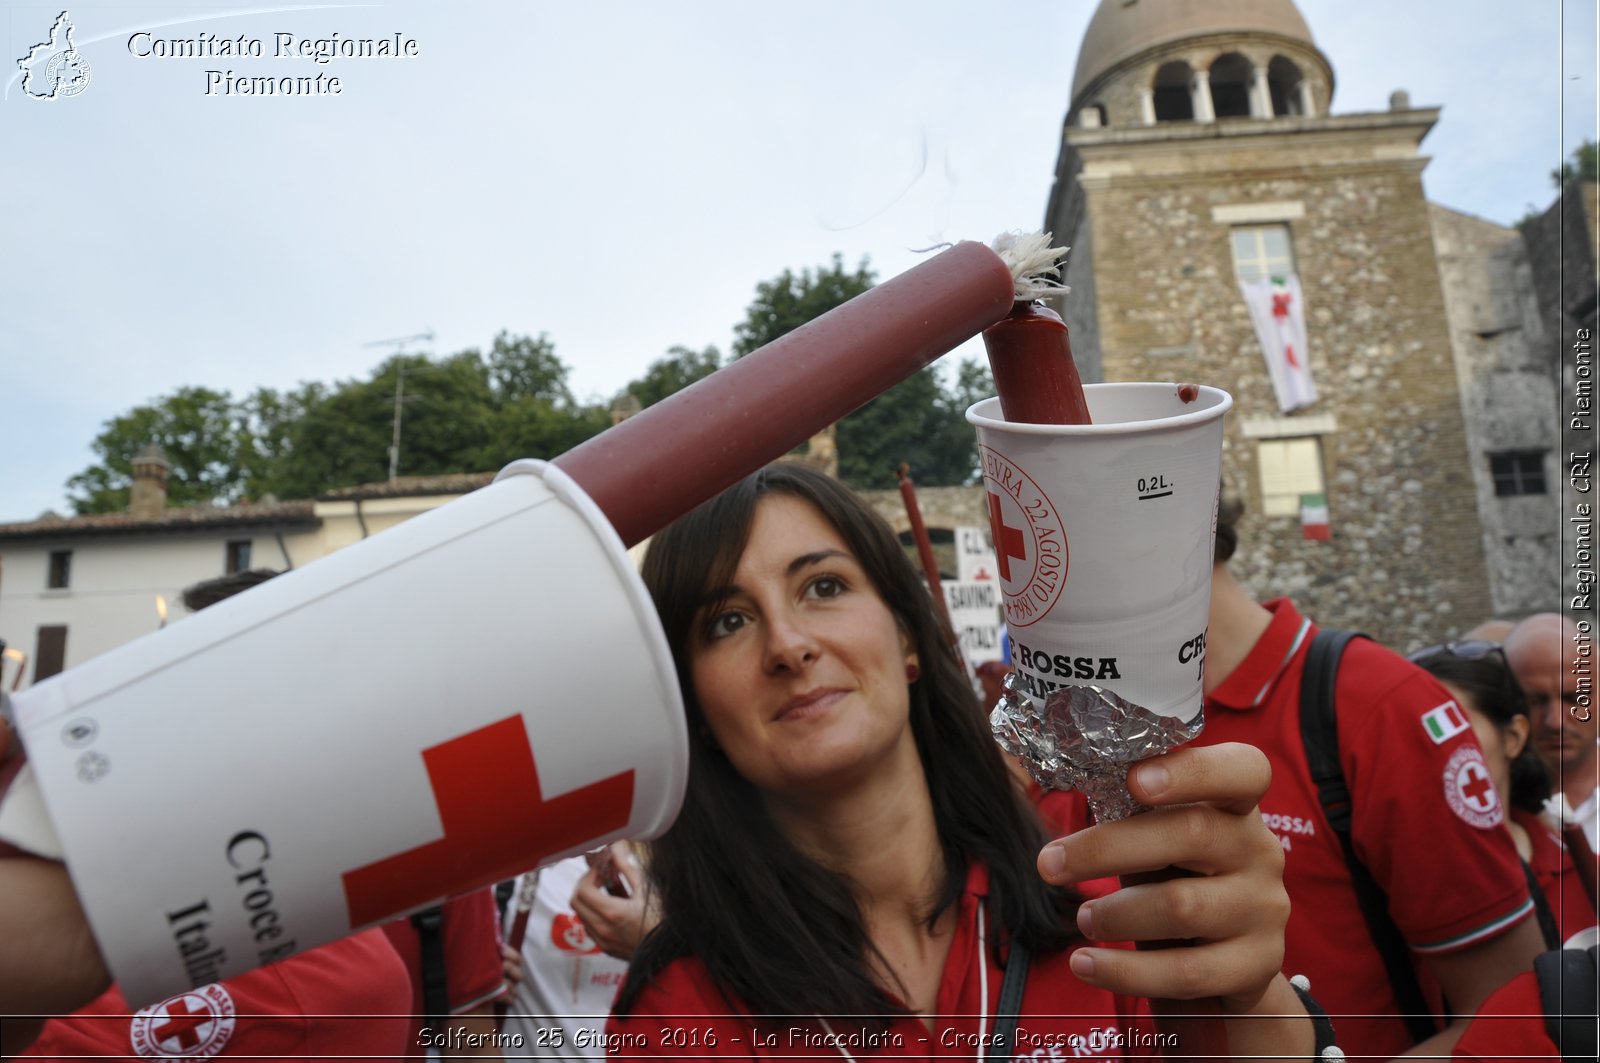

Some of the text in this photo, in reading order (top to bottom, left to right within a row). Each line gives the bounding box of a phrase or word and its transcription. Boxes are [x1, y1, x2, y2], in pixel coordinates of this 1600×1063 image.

[1024, 498, 1049, 523] 22
[1031, 526, 1062, 603] AGOSTO
[1013, 592, 1039, 621] 1864
[1018, 643, 1122, 680] ROSSA
[226, 829, 284, 944] Croce
